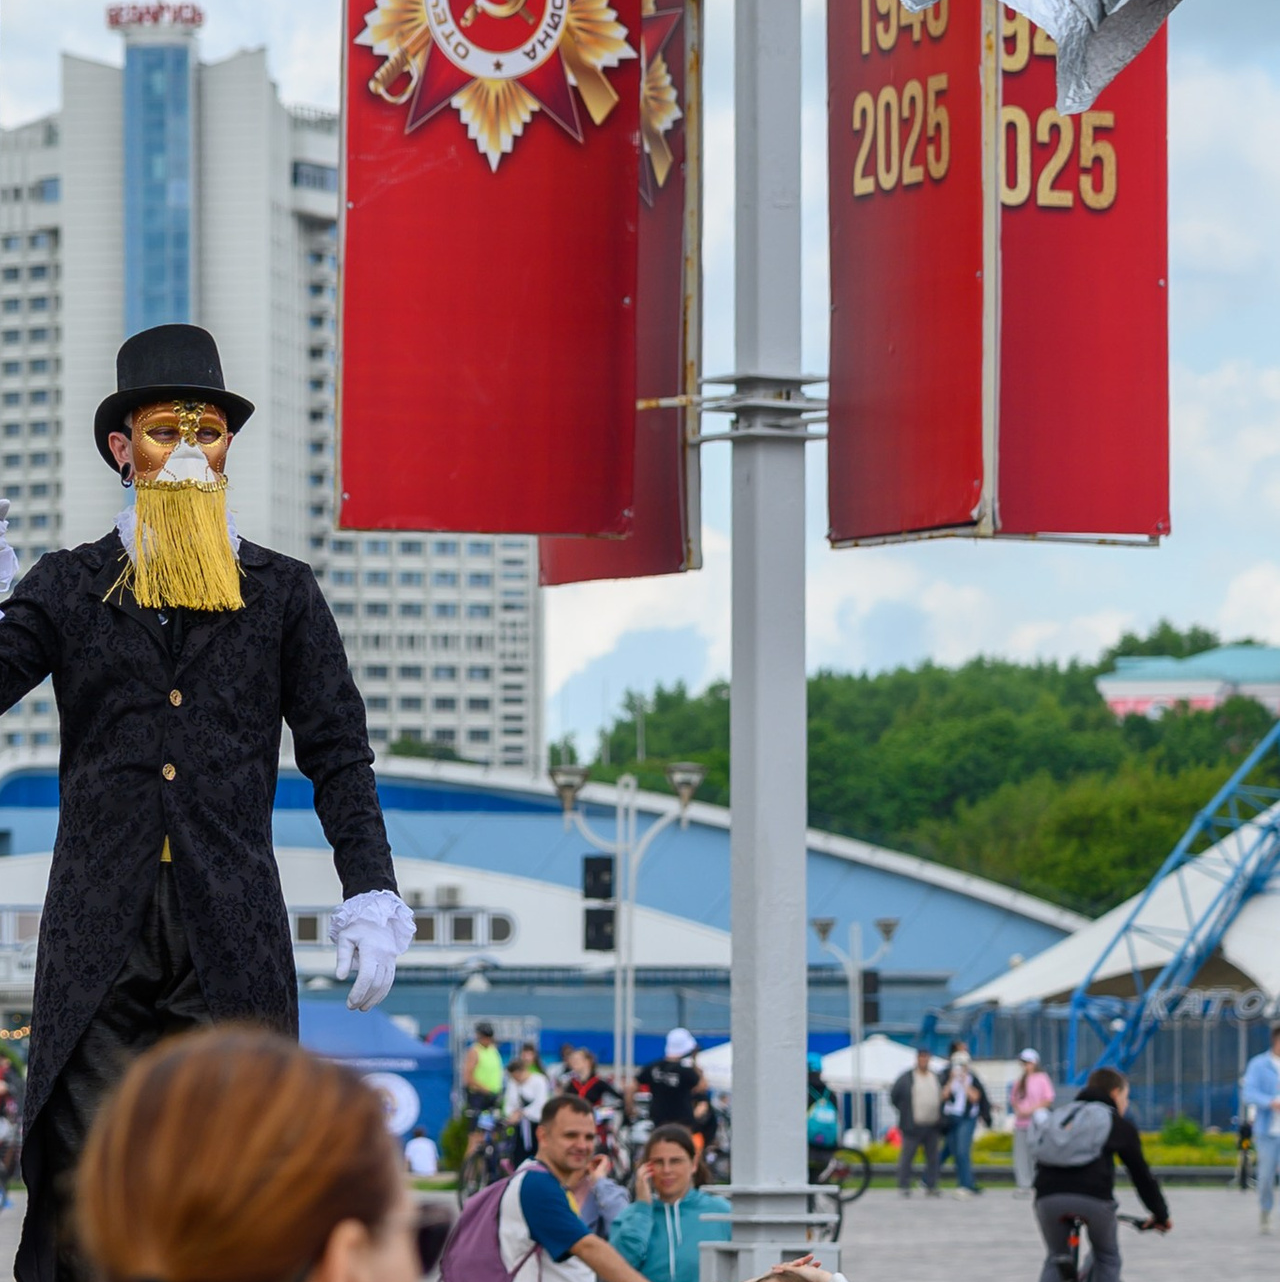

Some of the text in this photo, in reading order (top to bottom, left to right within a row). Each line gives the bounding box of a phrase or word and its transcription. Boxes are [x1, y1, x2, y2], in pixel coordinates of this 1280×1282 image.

[852, 73, 950, 198] 2025
[1001, 105, 1117, 209] 025
[1141, 986, 1280, 1022] КАТО
